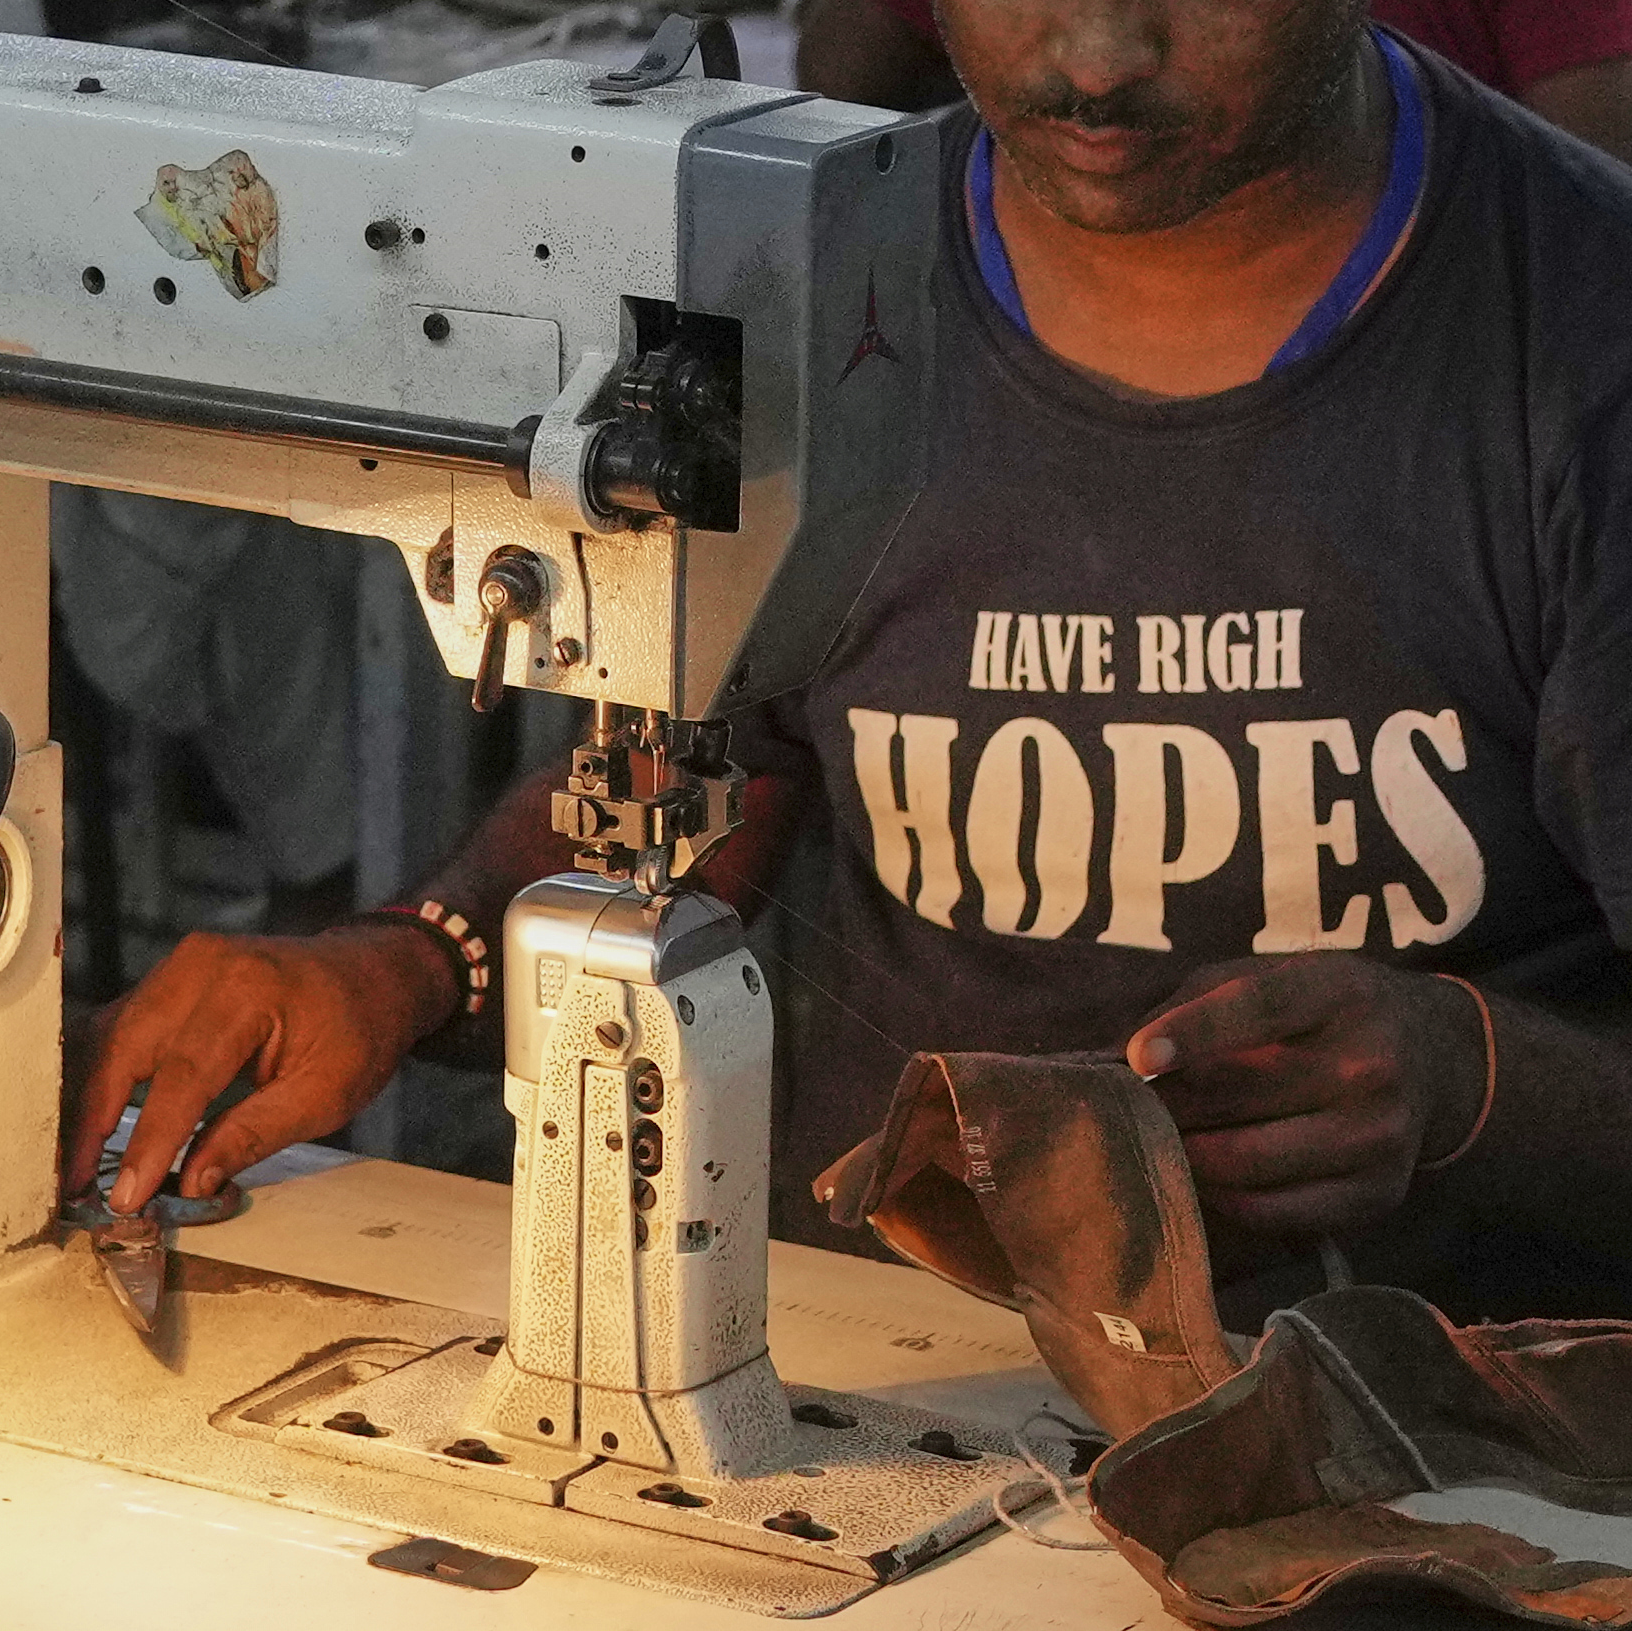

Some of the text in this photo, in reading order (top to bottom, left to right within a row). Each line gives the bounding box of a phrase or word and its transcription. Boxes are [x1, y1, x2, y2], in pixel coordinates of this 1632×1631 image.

[969, 608, 1304, 693] HAVE RIGH
[847, 708, 1486, 954] HOPES
